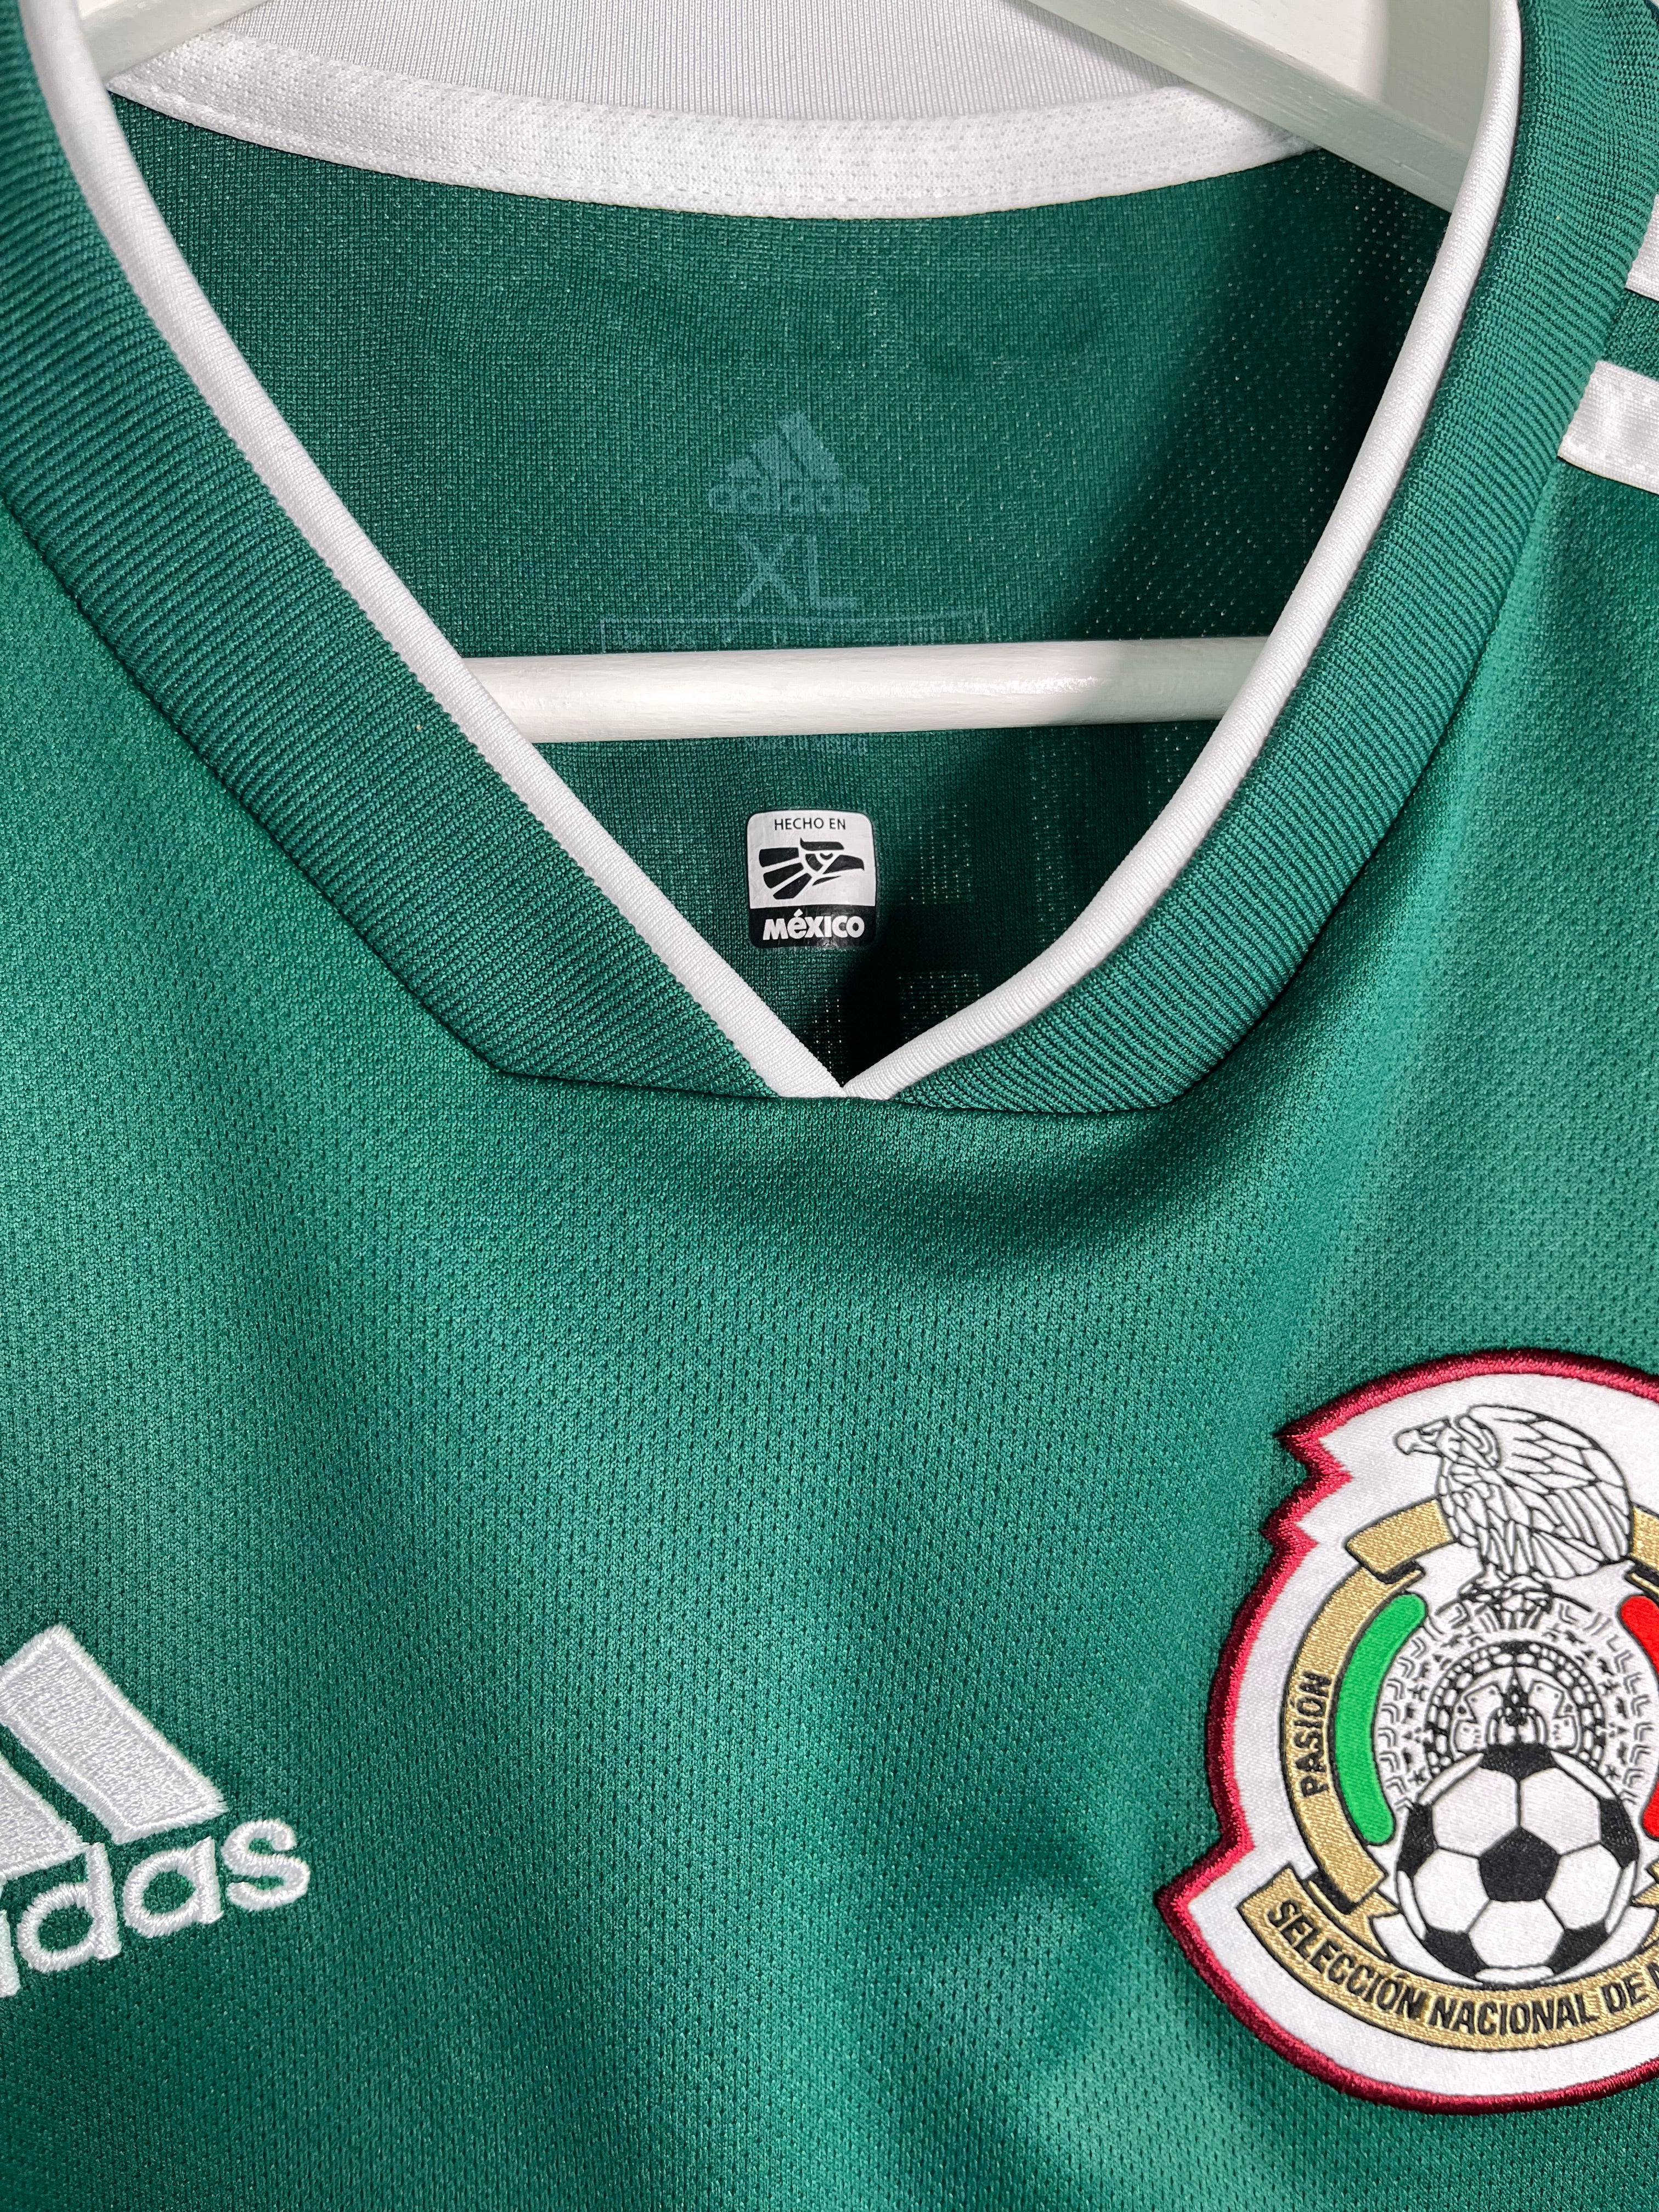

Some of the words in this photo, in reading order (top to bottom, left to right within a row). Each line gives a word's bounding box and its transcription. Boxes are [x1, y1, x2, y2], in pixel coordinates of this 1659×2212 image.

[707, 474, 871, 515] adidas
[735, 531, 857, 608] XL
[774, 817, 824, 831] HECHO
[830, 818, 846, 830] EN
[1290, 1669, 1331, 1798] PASIÓN
[1267, 1900, 1429, 2019] SELECCIÓN
[1429, 1993, 1598, 2035] NACIONAL
[1602, 1973, 1649, 2013] DE
